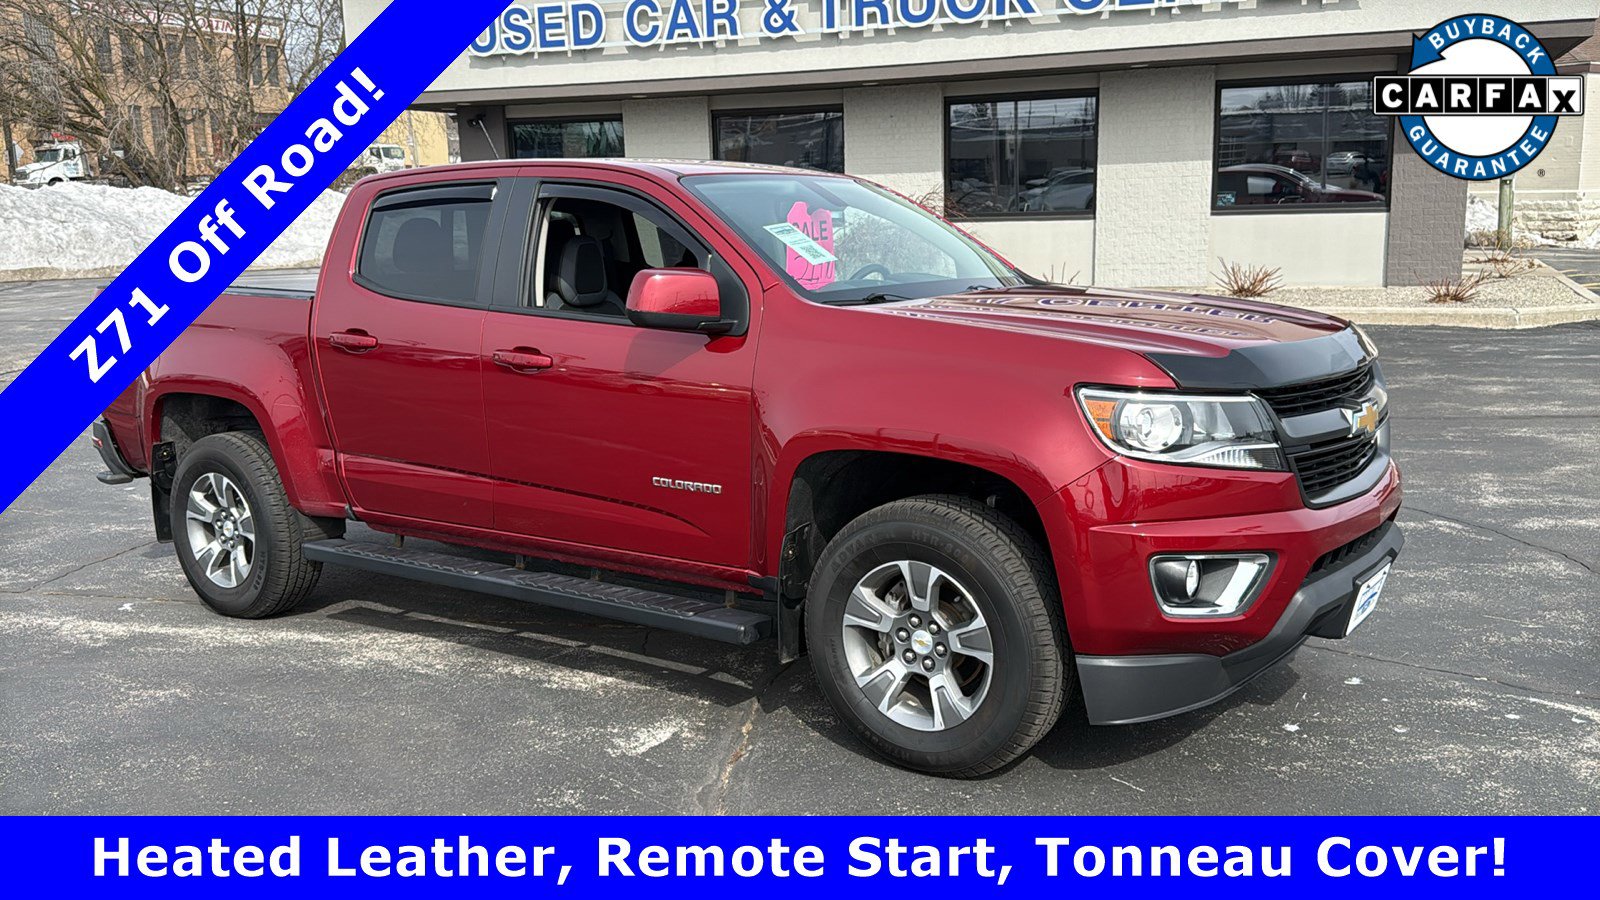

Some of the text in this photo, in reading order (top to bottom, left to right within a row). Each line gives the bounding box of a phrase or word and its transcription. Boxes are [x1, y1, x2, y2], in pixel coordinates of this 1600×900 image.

[624, 0, 742, 45] CAR
[761, 0, 804, 38] &
[652, 476, 722, 494] COLORADO
